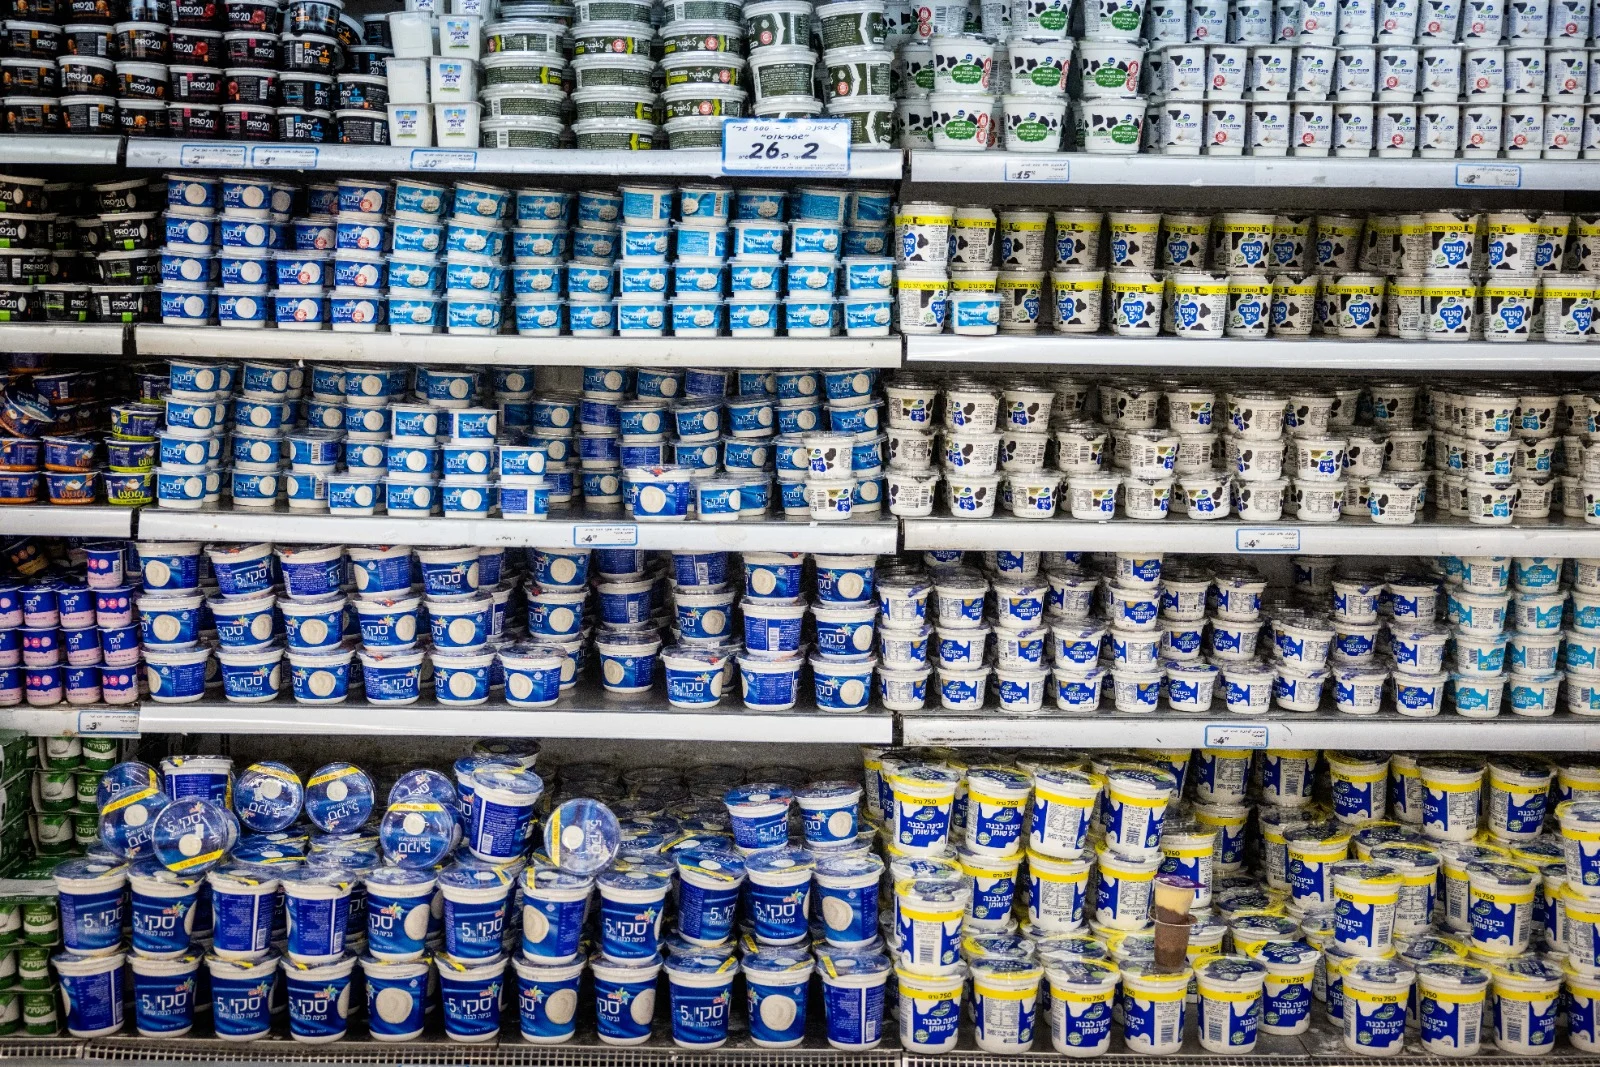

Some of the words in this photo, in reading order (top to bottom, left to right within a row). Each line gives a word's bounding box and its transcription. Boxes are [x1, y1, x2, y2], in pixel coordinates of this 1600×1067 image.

[749, 142, 779, 159] 26
[801, 143, 819, 159] 2
[251, 569, 266, 582] סקי
[440, 574, 460, 585] סקי
[222, 627, 243, 637] סקי
[371, 626, 388, 637] סקי
[825, 635, 845, 645] סקי
[243, 677, 262, 687] סקי
[395, 678, 414, 688] סקי
[684, 682, 704, 693] סקי
[1482, 893, 1495, 901] 750
[709, 906, 722, 921] 5%
[755, 901, 768, 916] 5%
[767, 903, 795, 919] סקי
[84, 913, 100, 928] 5%
[133, 911, 144, 928] 5%
[145, 915, 175, 930] סקי
[370, 915, 393, 929] סקי
[605, 919, 616, 934] 5%
[1343, 920, 1362, 928] גבינה
[1485, 919, 1504, 928] גבינה
[461, 922, 476, 937] 5%
[617, 921, 647, 937] סקי
[142, 994, 155, 1010] 5%
[157, 993, 186, 1010] סקי
[218, 997, 229, 1013] 5%
[231, 997, 260, 1013] סקי
[298, 999, 328, 1013] סקי
[449, 998, 462, 1013] 5%
[462, 998, 492, 1012] סקי
[680, 1005, 694, 1021] 5%
[695, 1005, 723, 1020] סקי
[929, 1024, 945, 1032] שומן
[939, 1017, 958, 1025] גבינה
[1365, 1020, 1384, 1028] לבנה
[1430, 1018, 1448, 1027] גבינה
[1082, 1027, 1099, 1035] שומן
[1432, 1024, 1442, 1033] 5%
